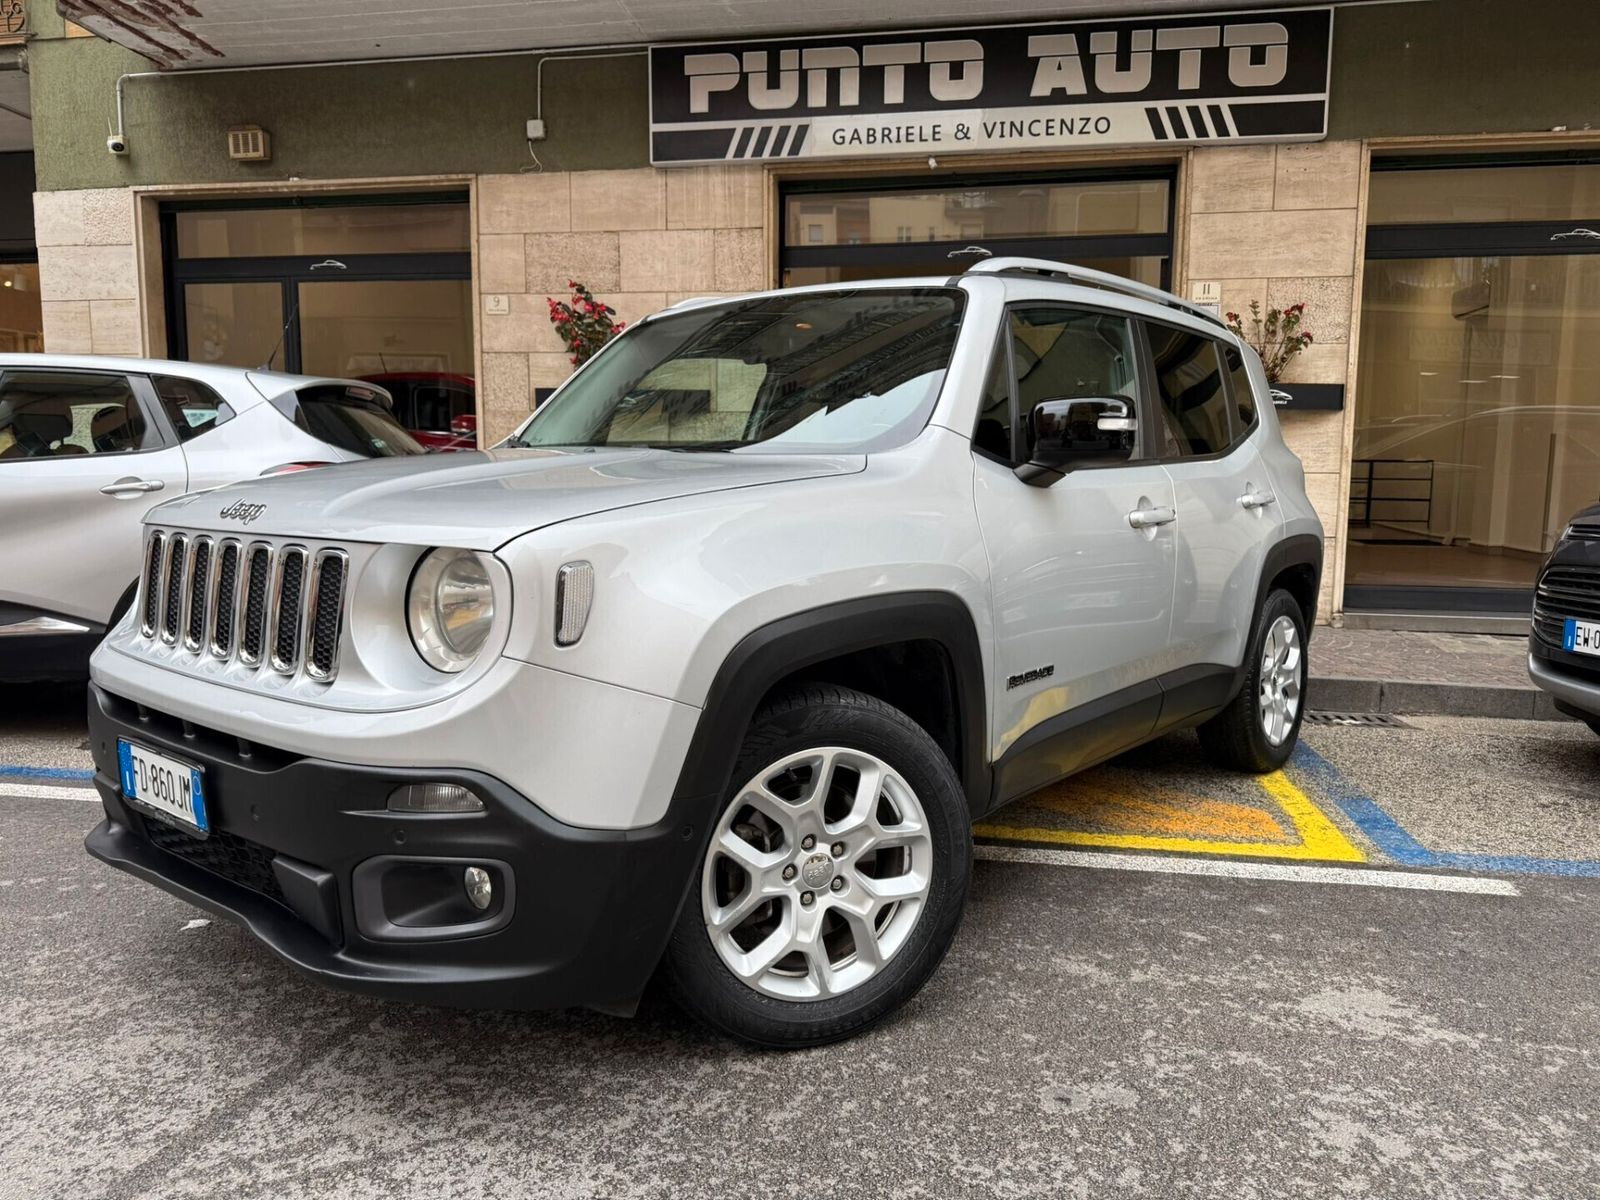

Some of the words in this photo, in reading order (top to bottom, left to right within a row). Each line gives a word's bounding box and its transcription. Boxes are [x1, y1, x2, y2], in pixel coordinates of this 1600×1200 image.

[684, 38, 984, 113] PUNTO
[1027, 22, 1289, 97] AUTO
[832, 124, 942, 146] GABRIELE
[954, 122, 971, 140] &
[982, 116, 1111, 139] VINCENZO
[220, 497, 267, 525] Jeep
